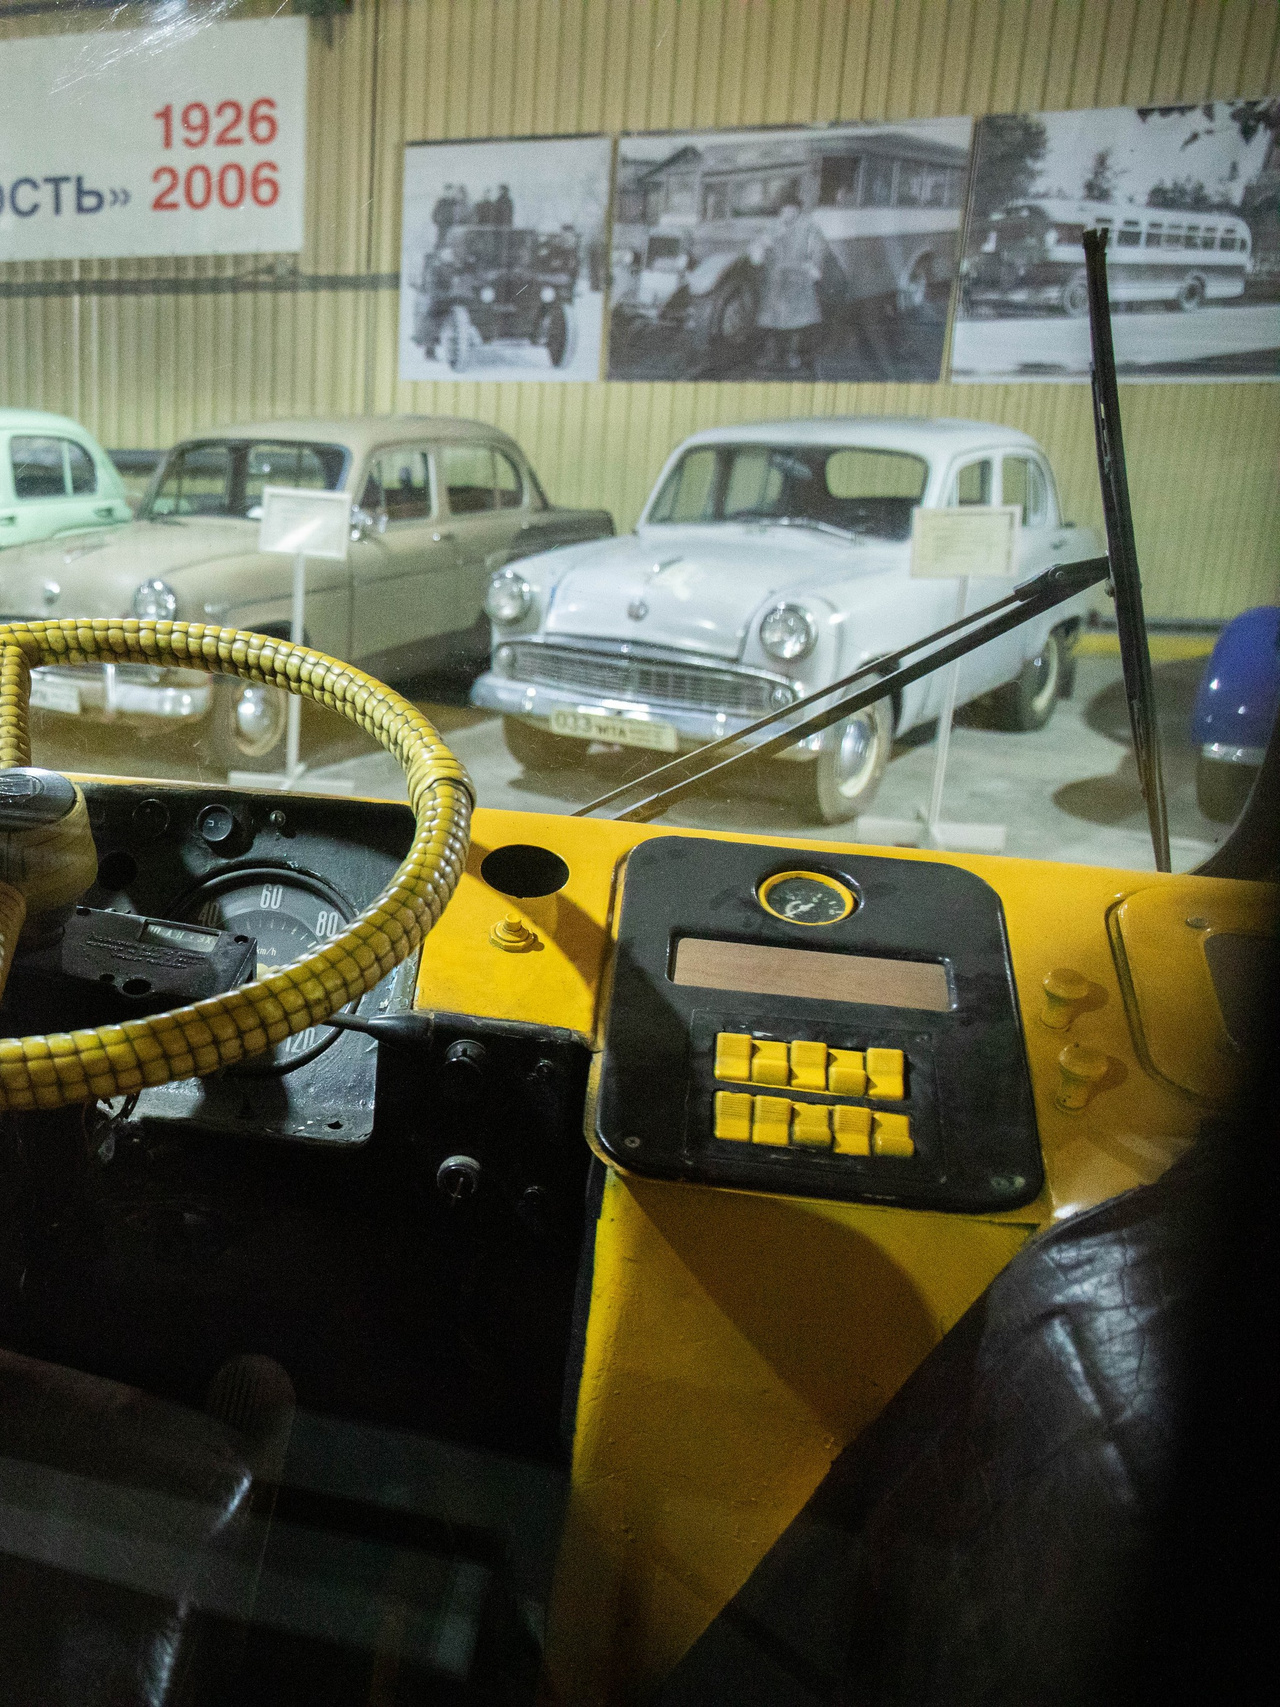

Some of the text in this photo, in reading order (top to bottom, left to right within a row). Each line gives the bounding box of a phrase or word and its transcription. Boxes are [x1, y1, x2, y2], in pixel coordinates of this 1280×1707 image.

[154, 97, 279, 150] 1926
[152, 161, 280, 212] 2006
[260, 884, 282, 909] 60
[198, 901, 220, 926] 40
[316, 910, 338, 937] 80
